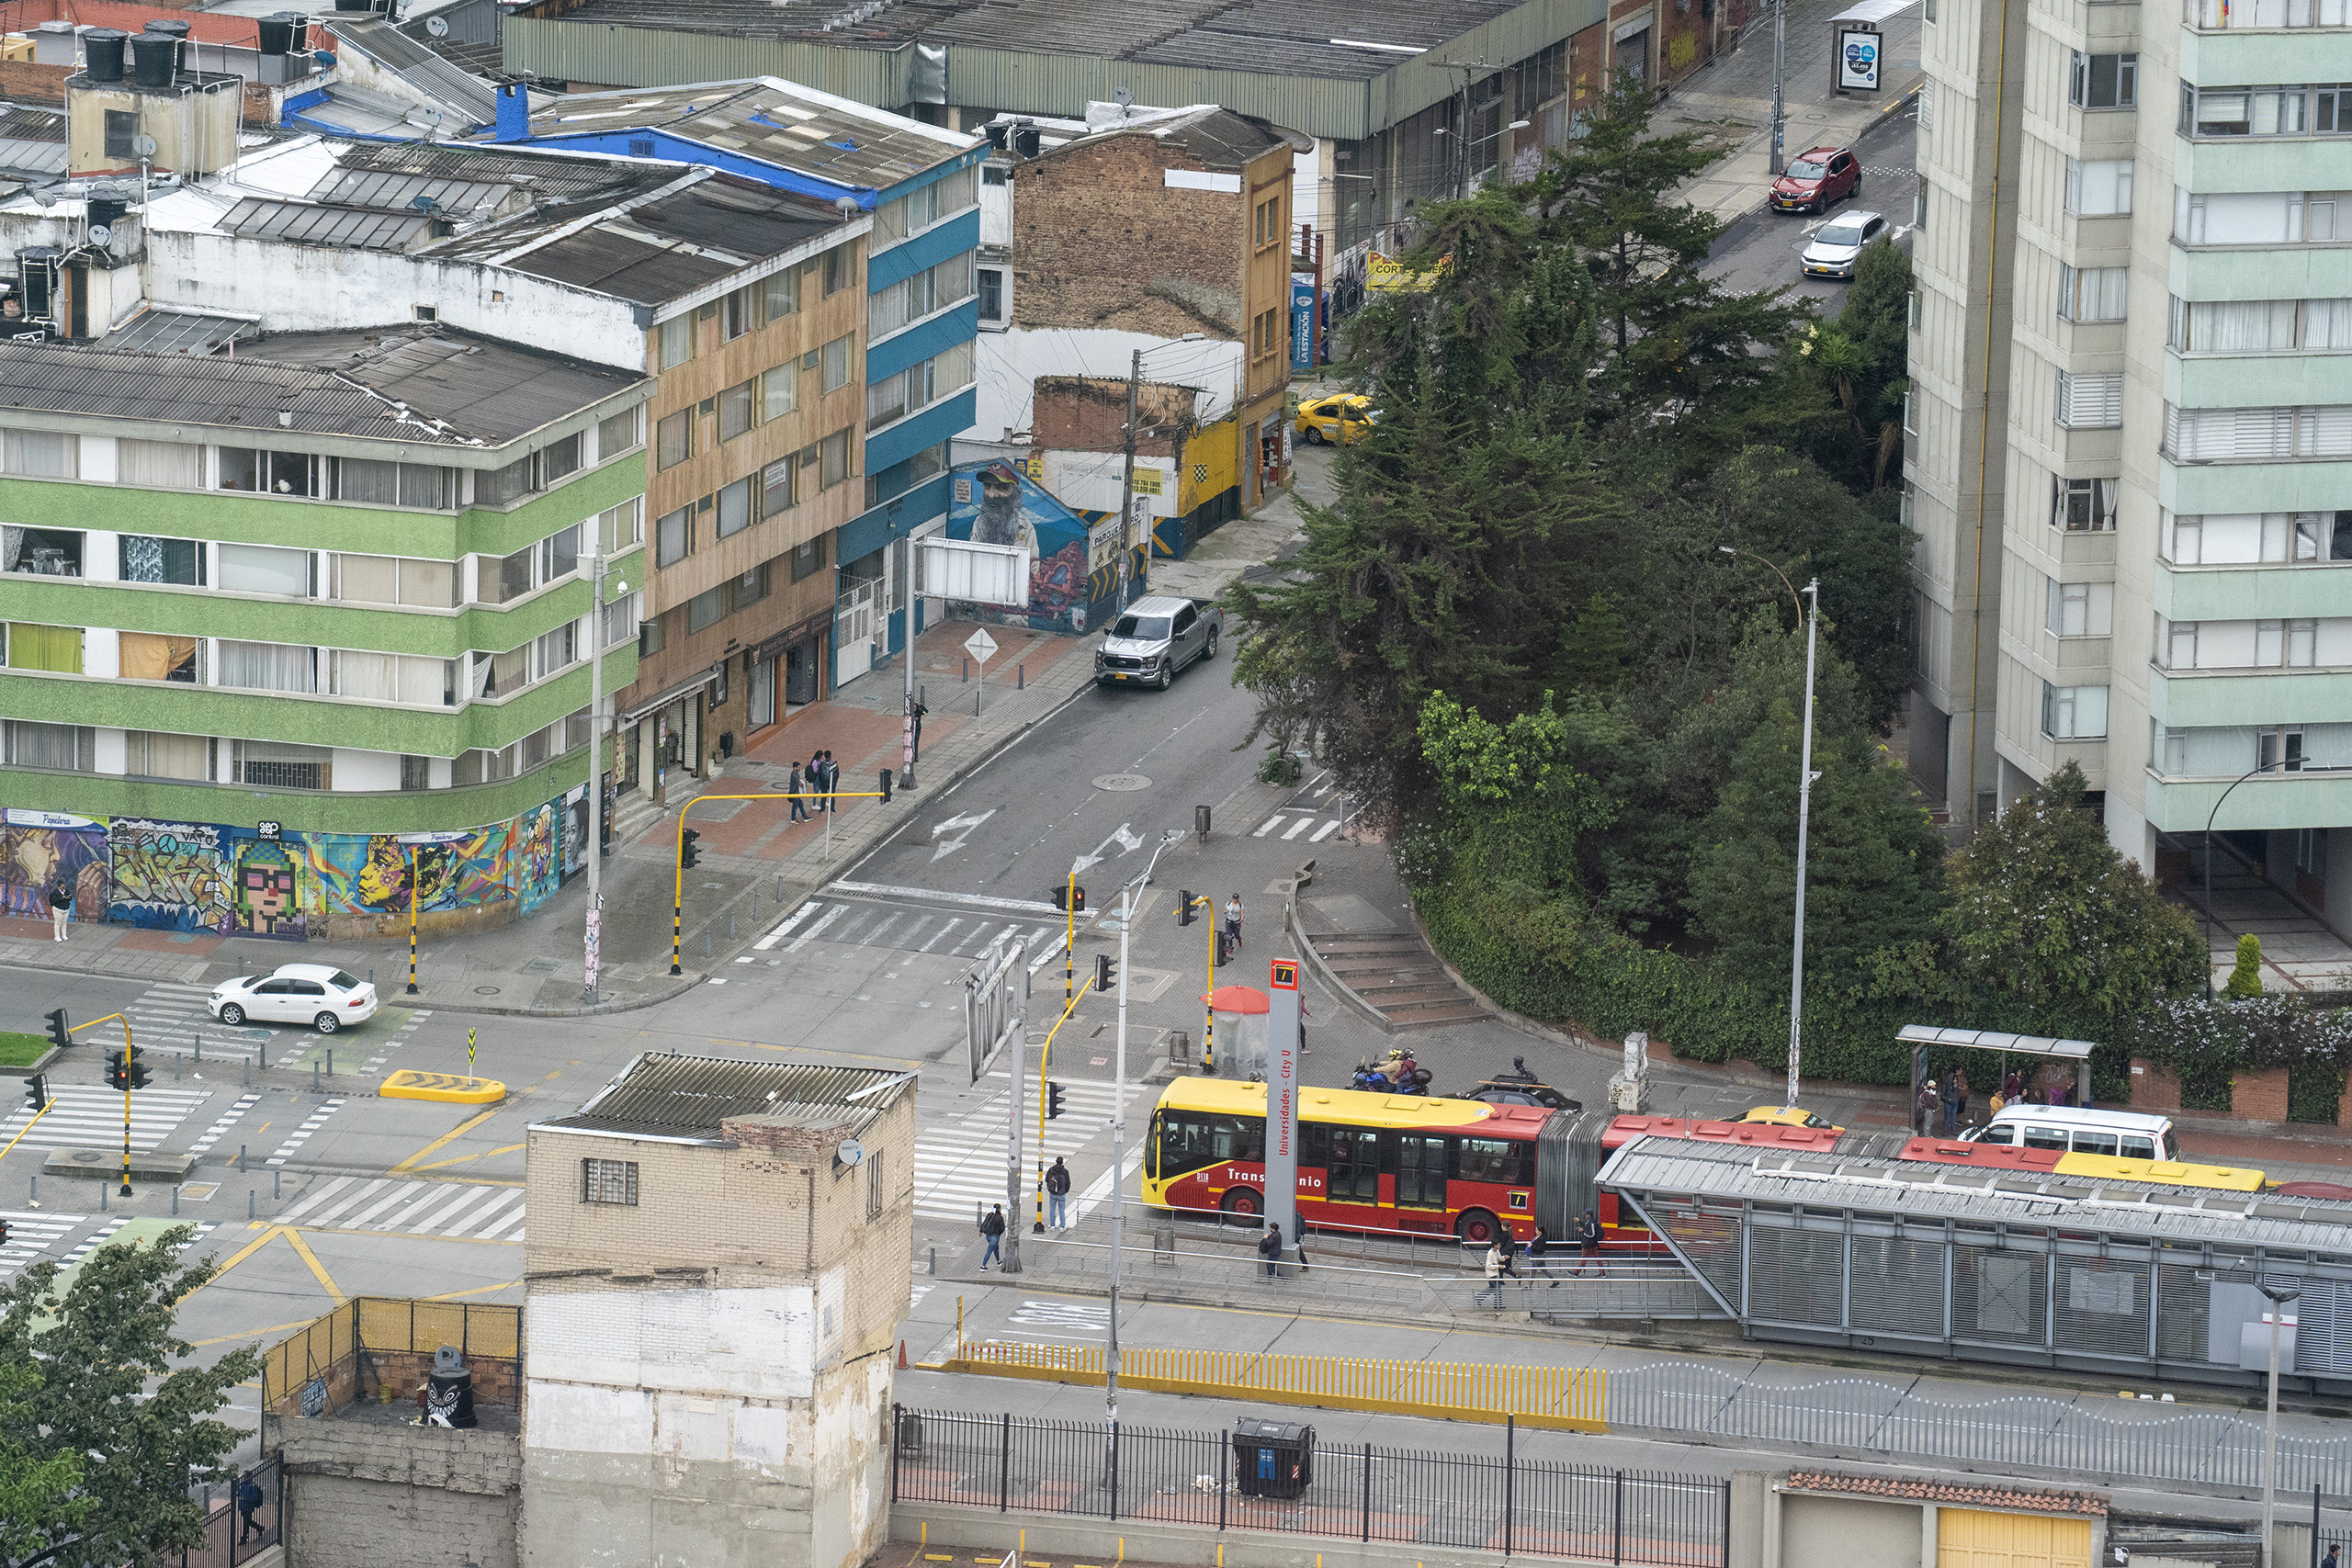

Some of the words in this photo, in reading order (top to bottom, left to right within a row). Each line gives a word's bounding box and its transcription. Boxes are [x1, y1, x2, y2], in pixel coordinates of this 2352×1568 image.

[1300, 311, 1309, 352] ESTACIÓN
[1301, 352, 1308, 363] LA
[42, 814, 71, 826] Papelera
[1281, 1058, 1293, 1079] City
[1278, 1089, 1290, 1156] Universidades
